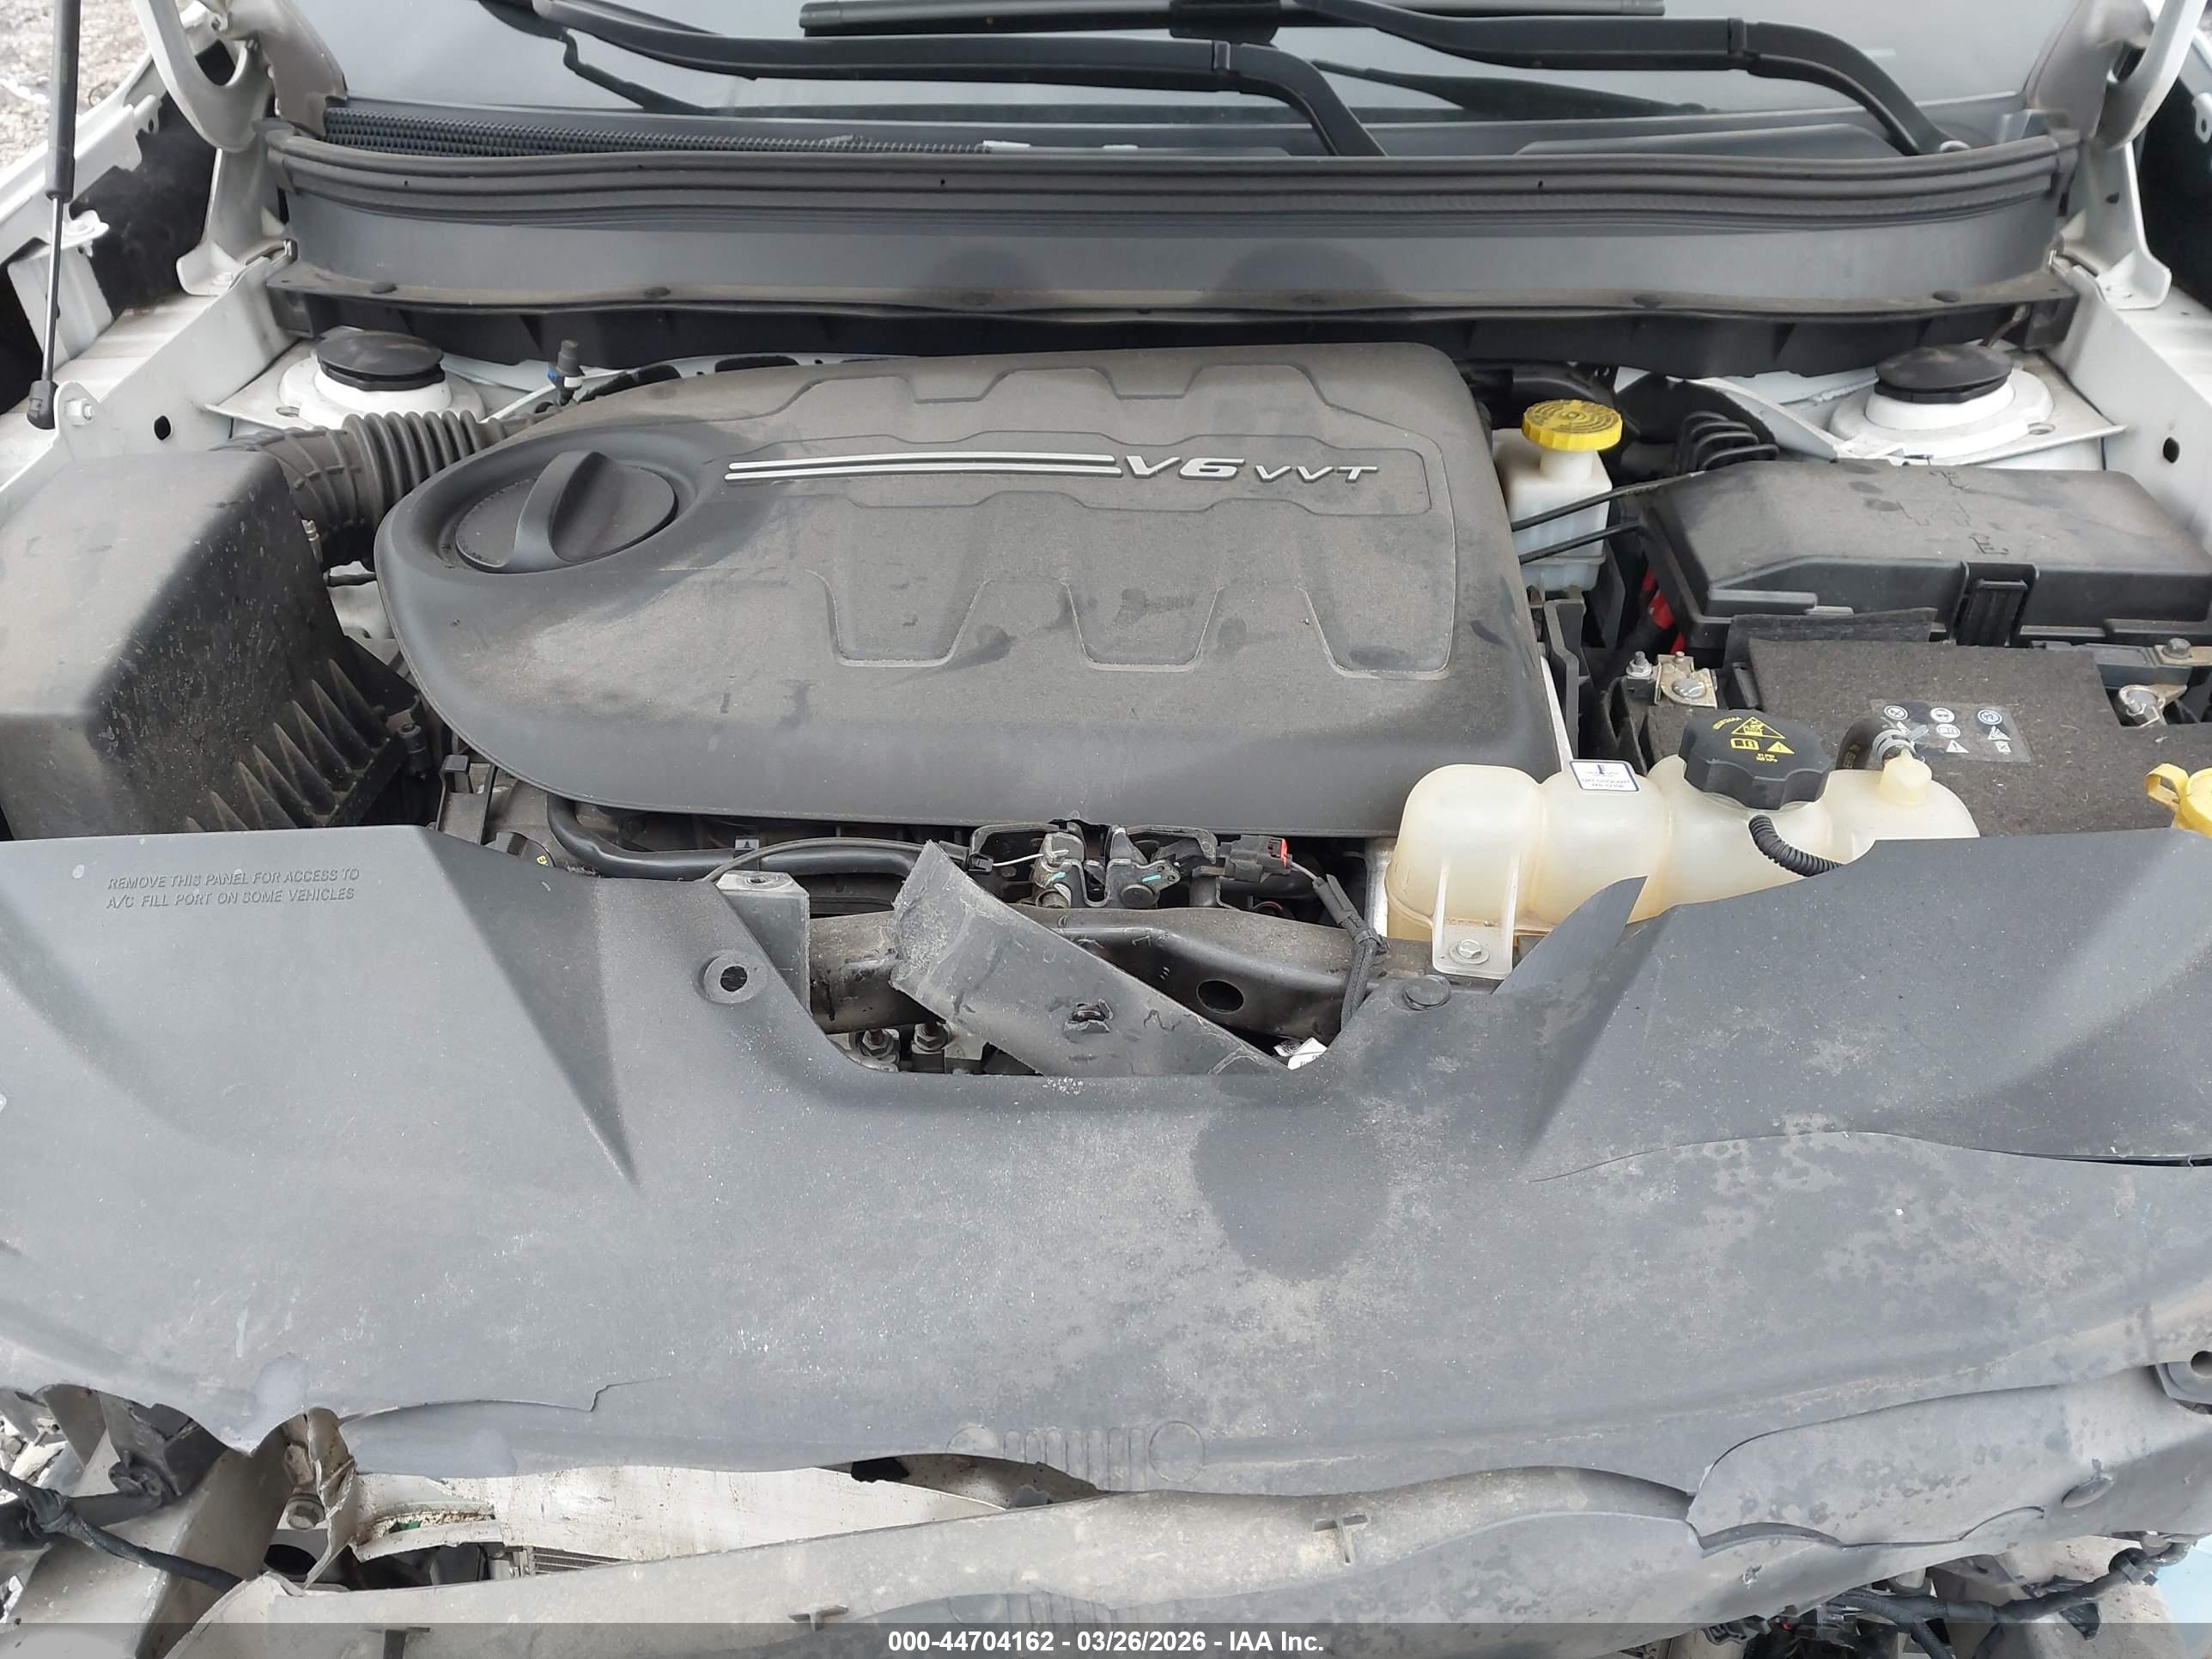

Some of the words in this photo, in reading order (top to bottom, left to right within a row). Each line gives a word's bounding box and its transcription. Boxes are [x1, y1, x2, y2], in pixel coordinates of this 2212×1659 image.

[1126, 455, 1246, 480] V6
[1255, 465, 1378, 483] VVT
[107, 876, 166, 890] REMOVE
[170, 873, 202, 887] THIS
[204, 872, 249, 886] PANEL
[252, 871, 281, 884] FOR
[283, 868, 338, 883] ACCESS
[341, 867, 360, 881] TO
[106, 895, 135, 908] A/C
[141, 894, 170, 908] FILL
[174, 892, 213, 906] PORT
[217, 891, 239, 904] ON
[242, 889, 283, 903] SOME
[288, 887, 356, 902] VEHICLES
